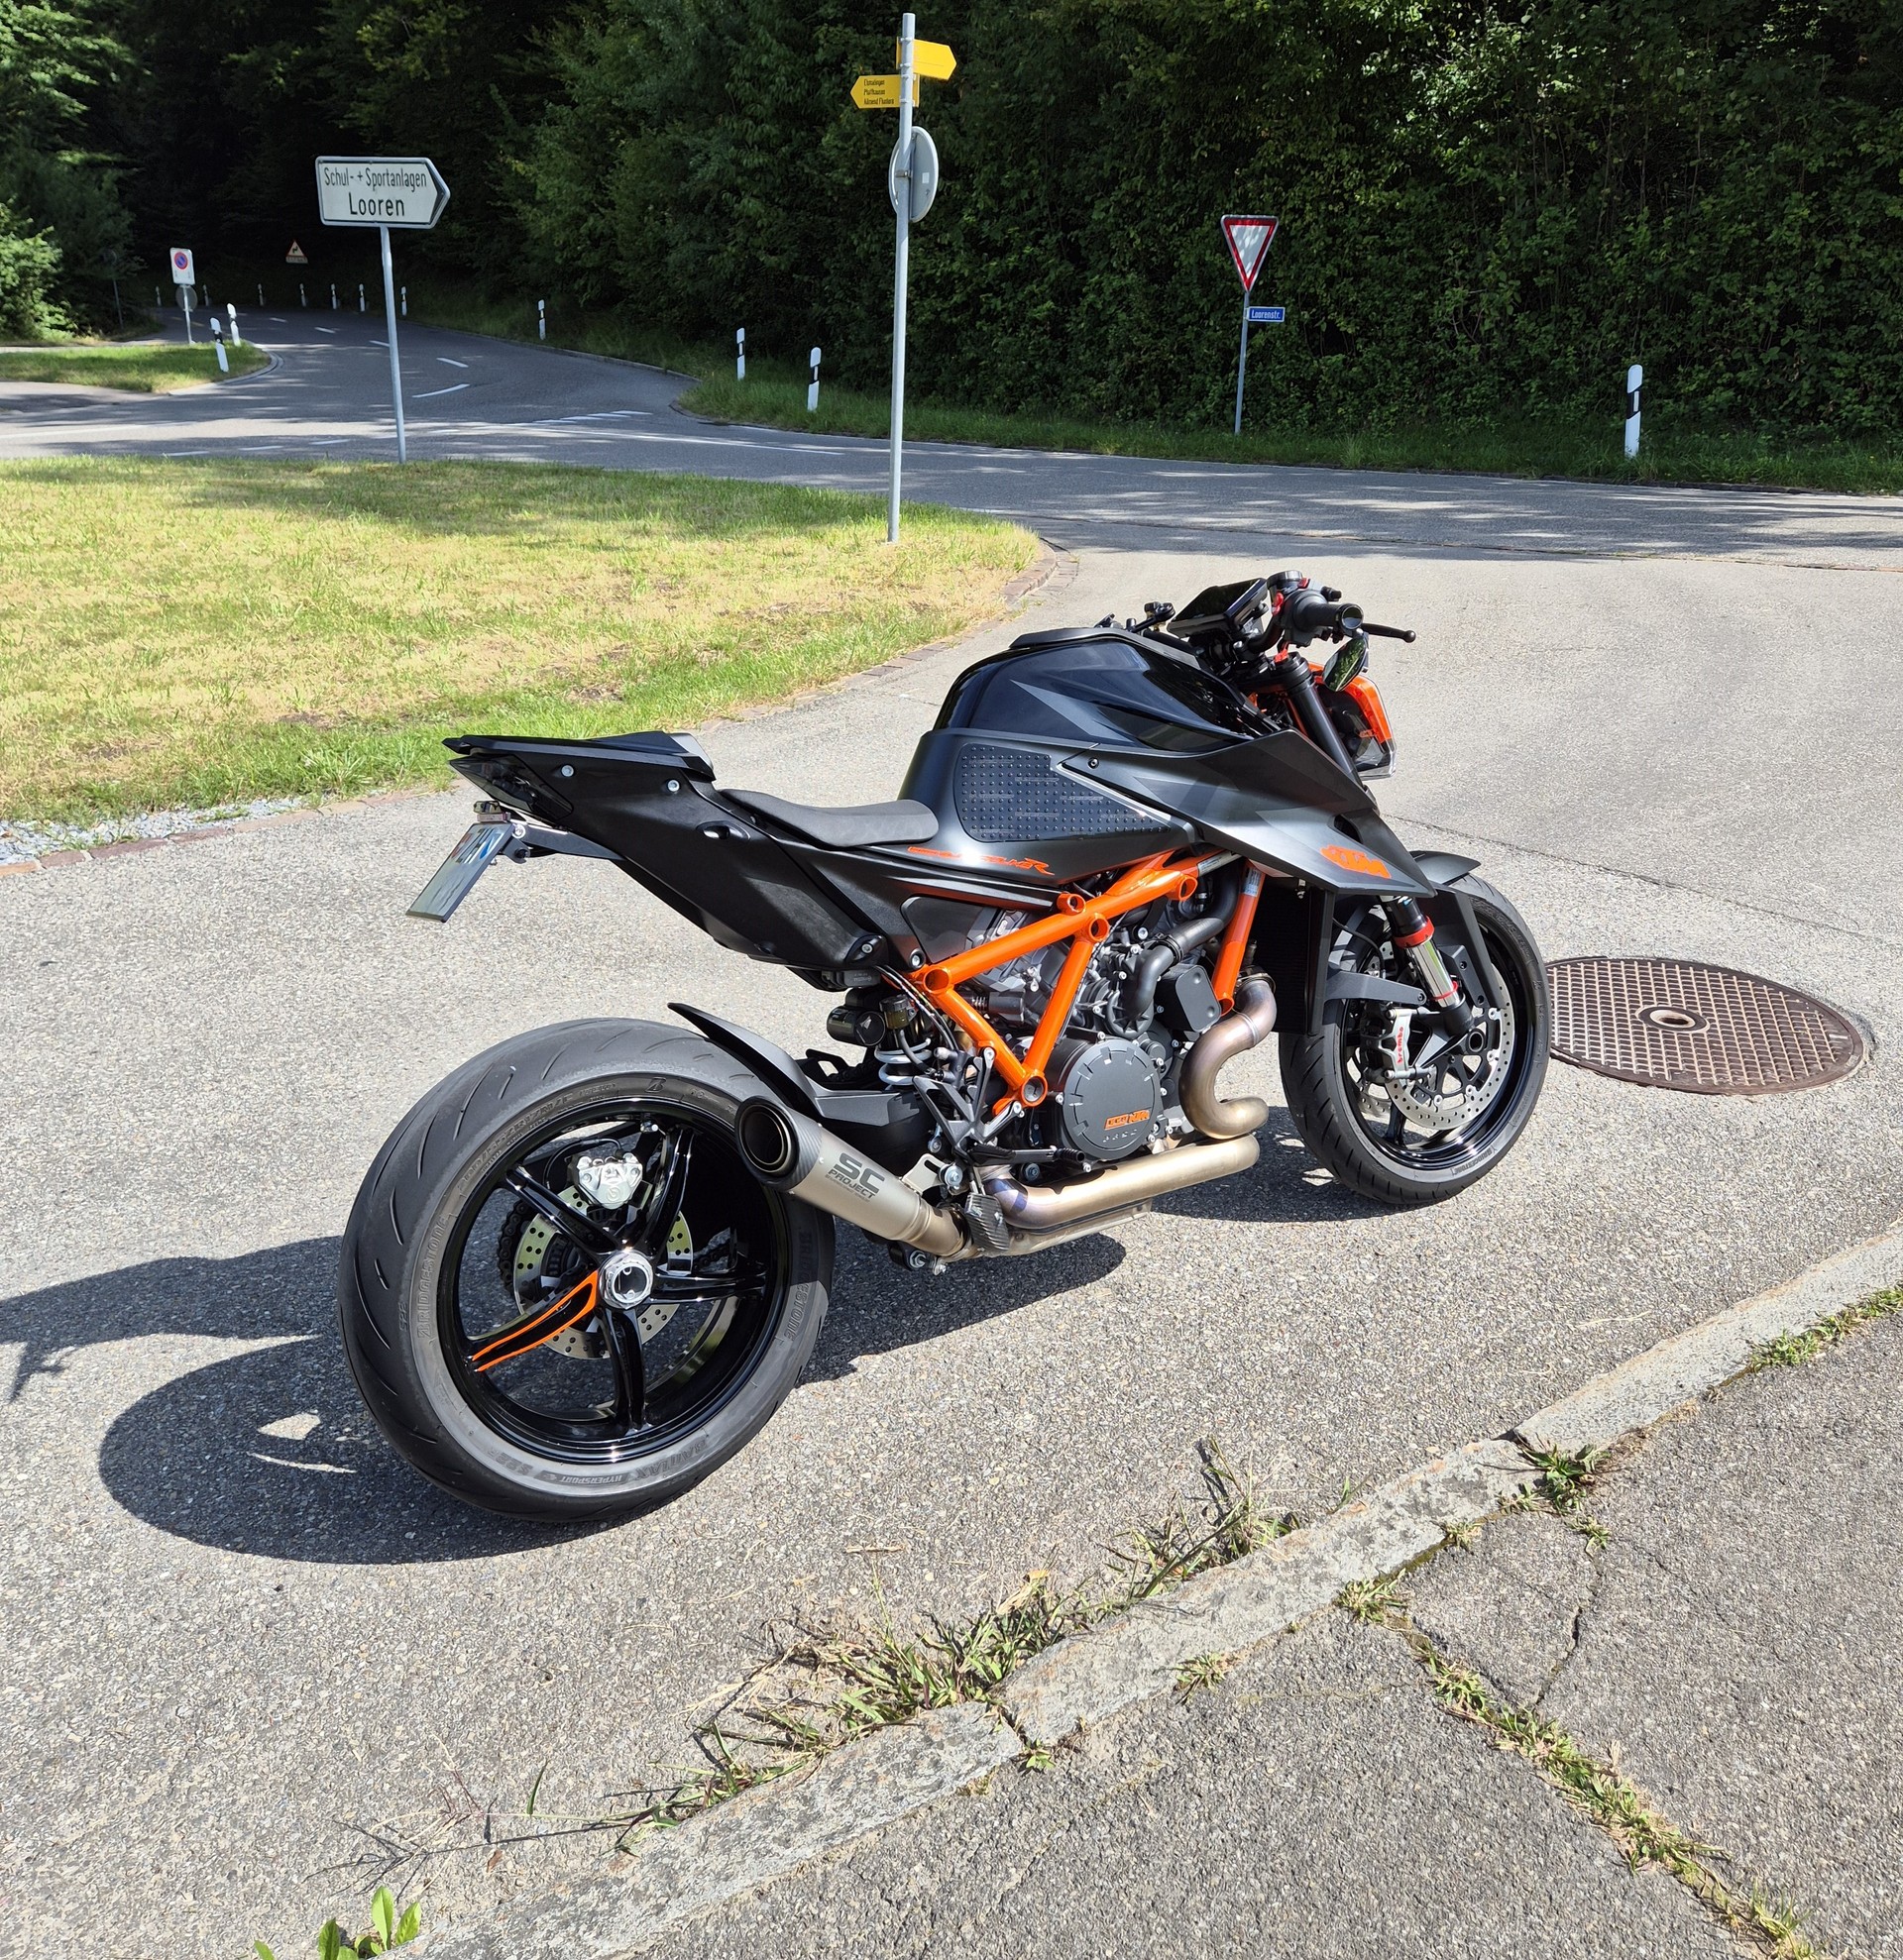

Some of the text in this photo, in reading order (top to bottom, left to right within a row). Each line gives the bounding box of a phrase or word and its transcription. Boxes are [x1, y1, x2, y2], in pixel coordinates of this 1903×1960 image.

[324, 166, 354, 186] Schul-
[365, 166, 427, 192] Sportanlagen
[348, 191, 405, 216] Looren
[828, 1168, 876, 1199] PROJECT
[833, 1152, 886, 1194] SC
[417, 1215, 448, 1338] BRIDGESTONE
[559, 1473, 622, 1484] HYPERSPORT
